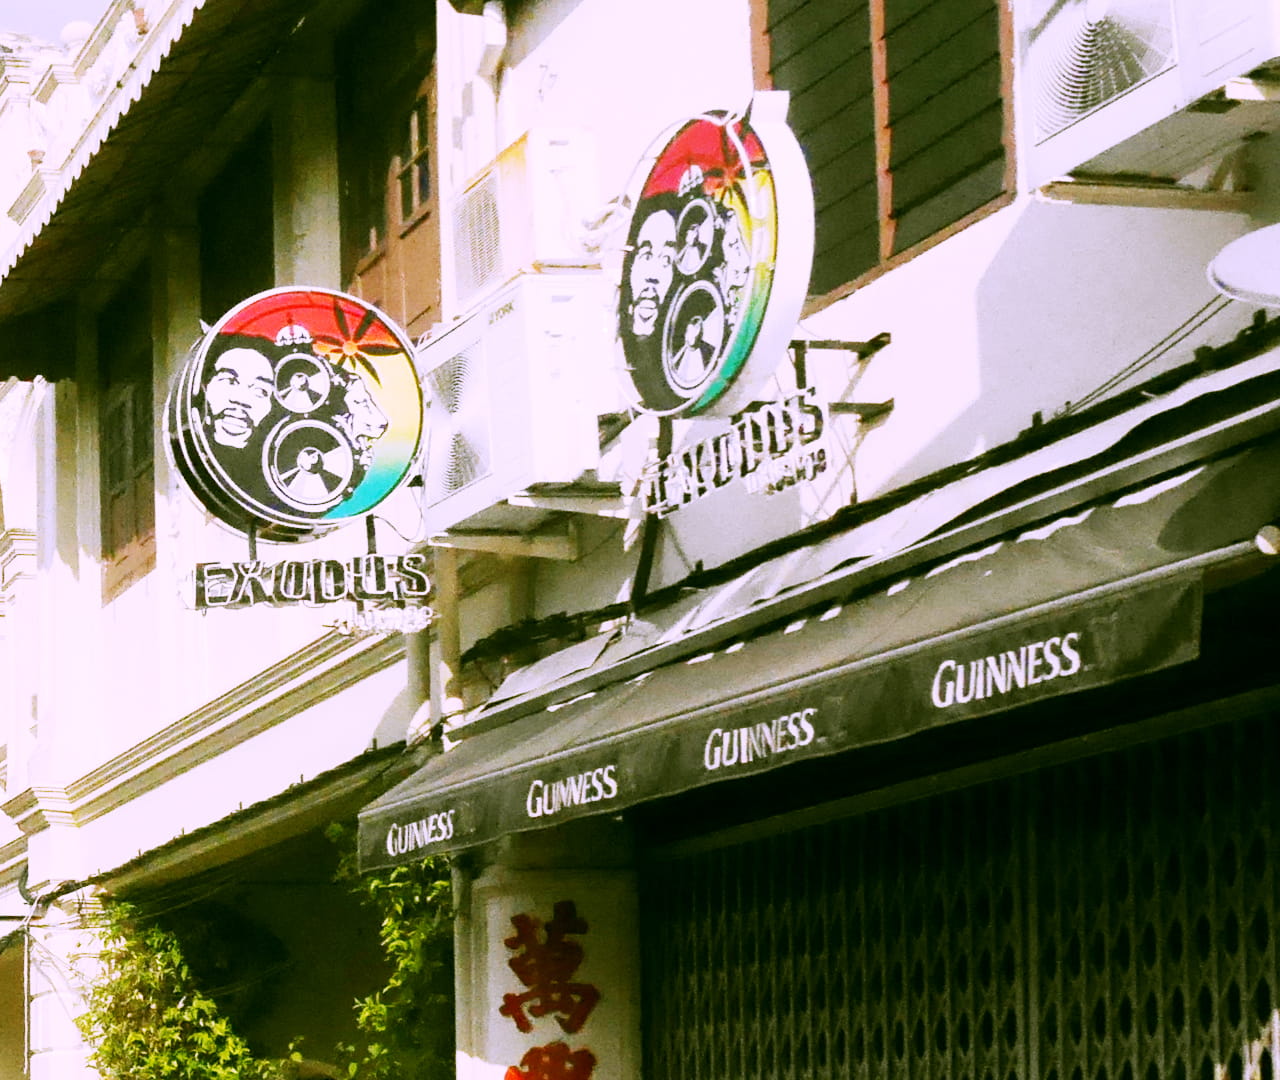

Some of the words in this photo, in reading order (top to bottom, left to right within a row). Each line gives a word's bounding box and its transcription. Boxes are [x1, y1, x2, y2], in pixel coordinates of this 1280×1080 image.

[196, 554, 431, 607] EXODUS
[932, 632, 1081, 708] GUINNESS
[703, 707, 817, 771] GUINNESS
[526, 765, 618, 818] GUINNESS
[386, 809, 455, 857] GUINNESS
